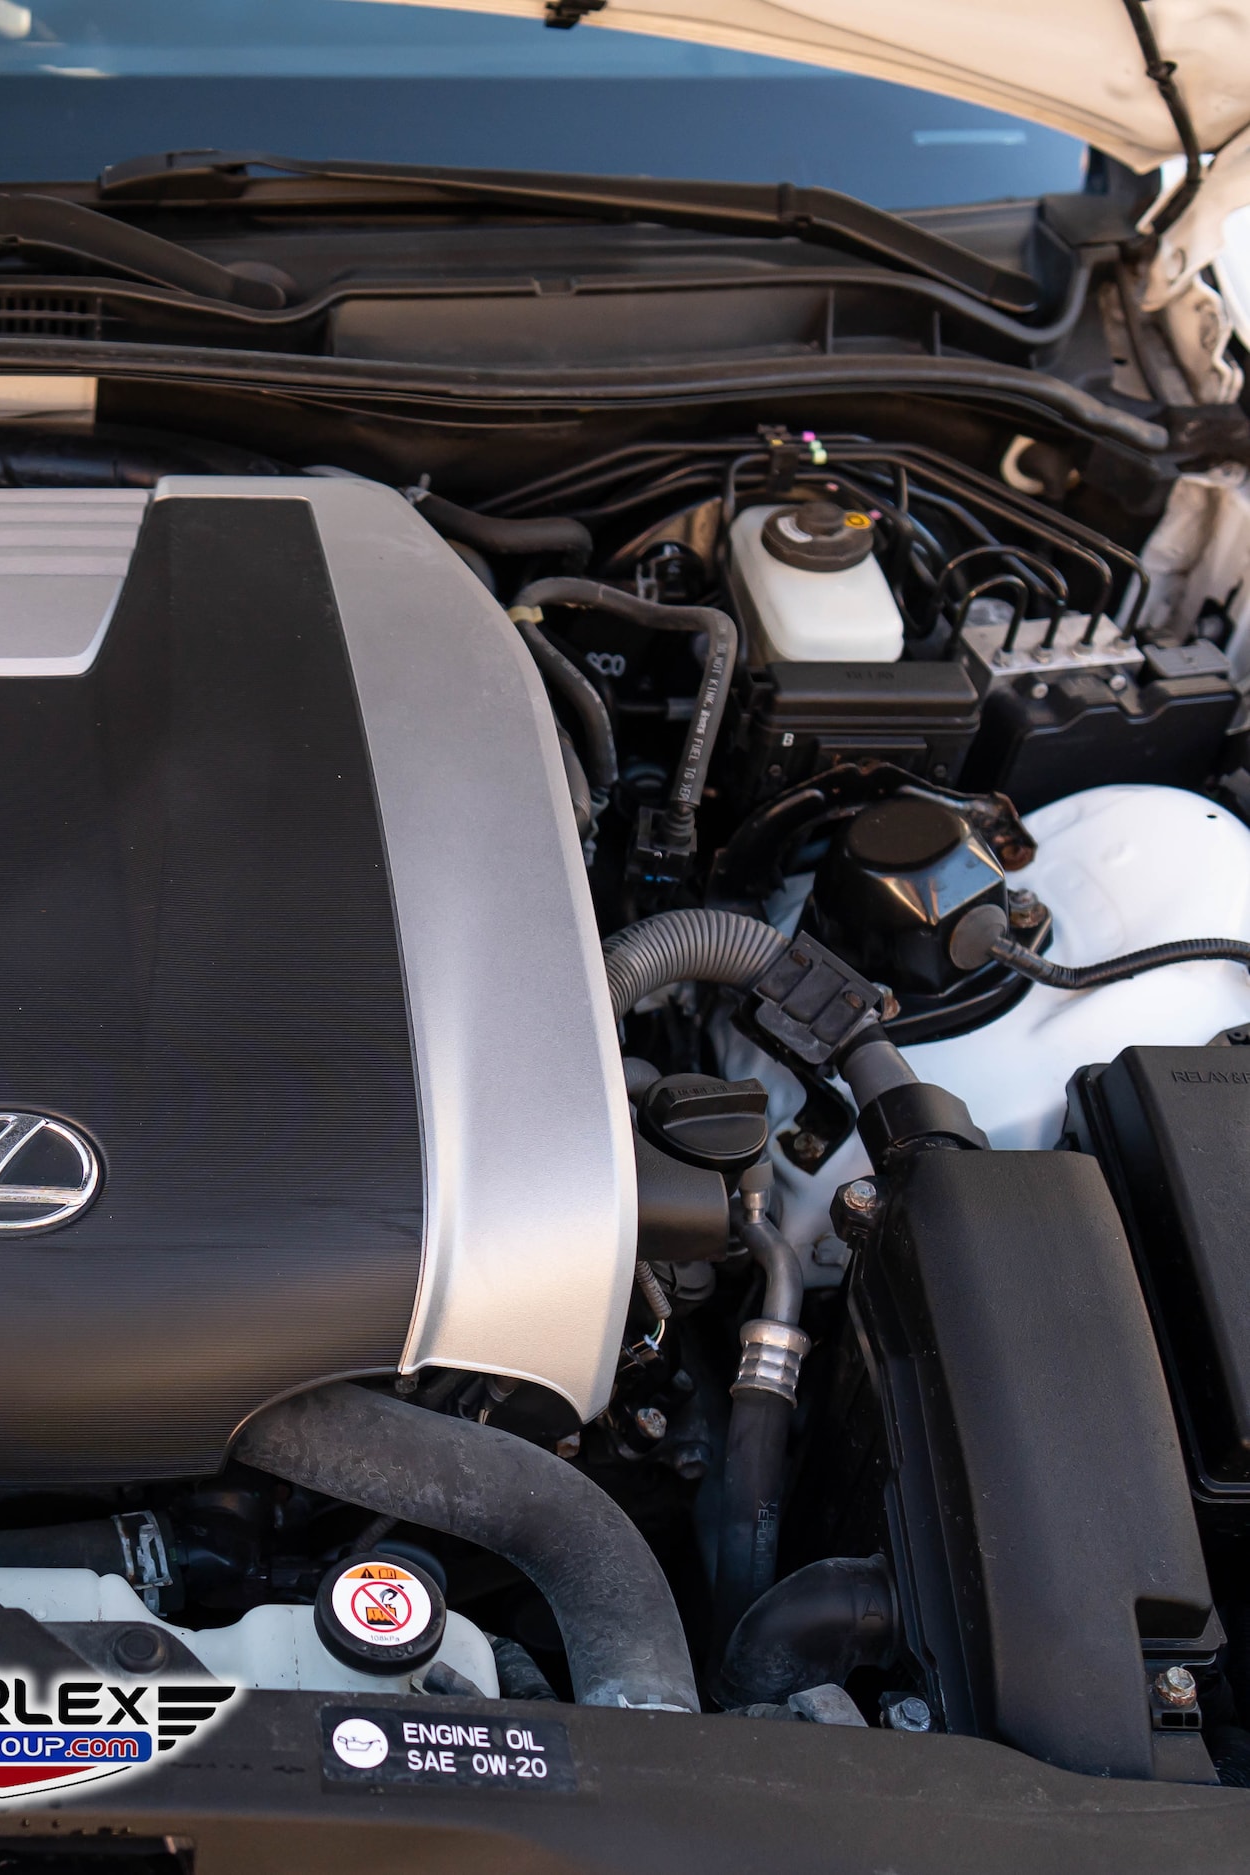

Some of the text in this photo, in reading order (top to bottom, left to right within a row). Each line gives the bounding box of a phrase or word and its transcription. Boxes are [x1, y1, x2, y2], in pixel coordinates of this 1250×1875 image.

[402, 1721, 545, 1752] ENGINE OIL
[407, 1749, 548, 1779] SAE 0W-20
